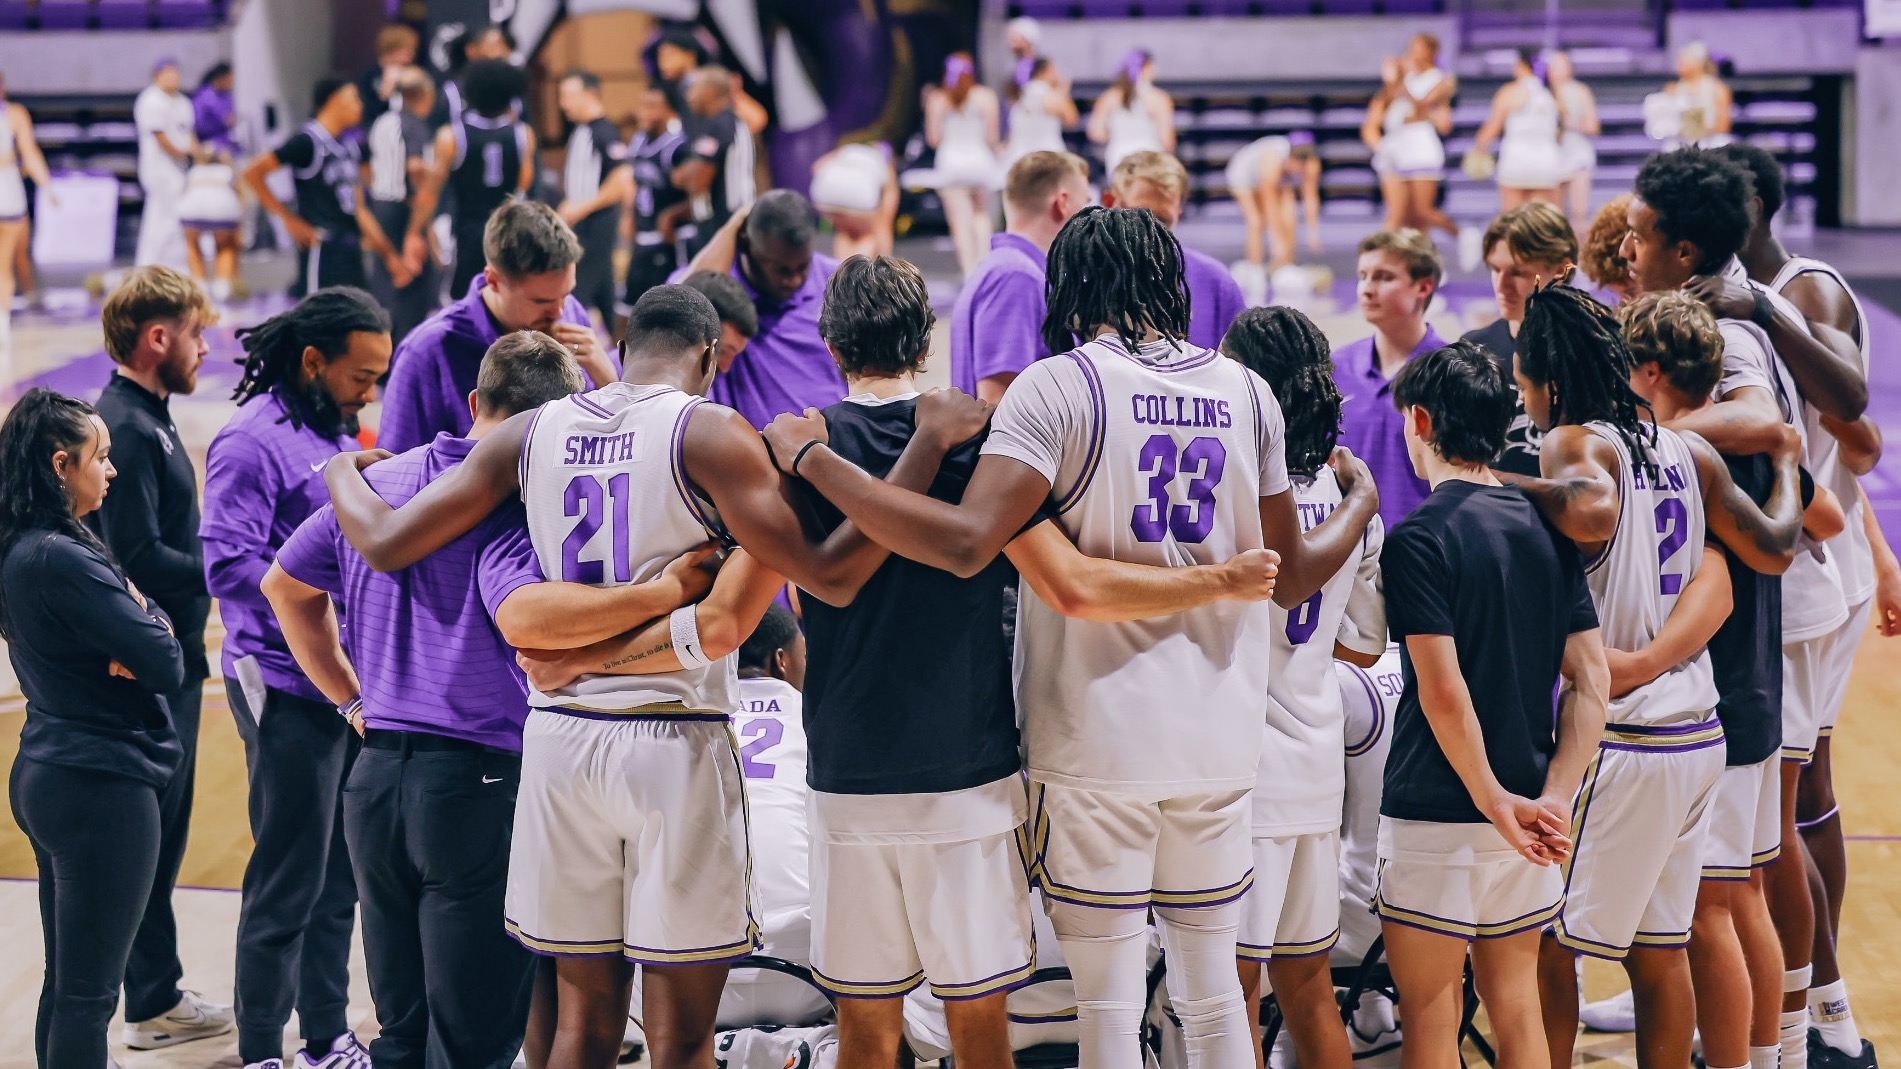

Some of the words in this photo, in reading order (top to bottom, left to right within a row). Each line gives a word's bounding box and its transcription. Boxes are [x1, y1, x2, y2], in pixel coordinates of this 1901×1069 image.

[564, 432, 635, 465] SMITH
[1132, 394, 1232, 428] COLLINS
[562, 473, 631, 583] 21
[1130, 434, 1227, 543] 33
[1654, 498, 1688, 595] 2
